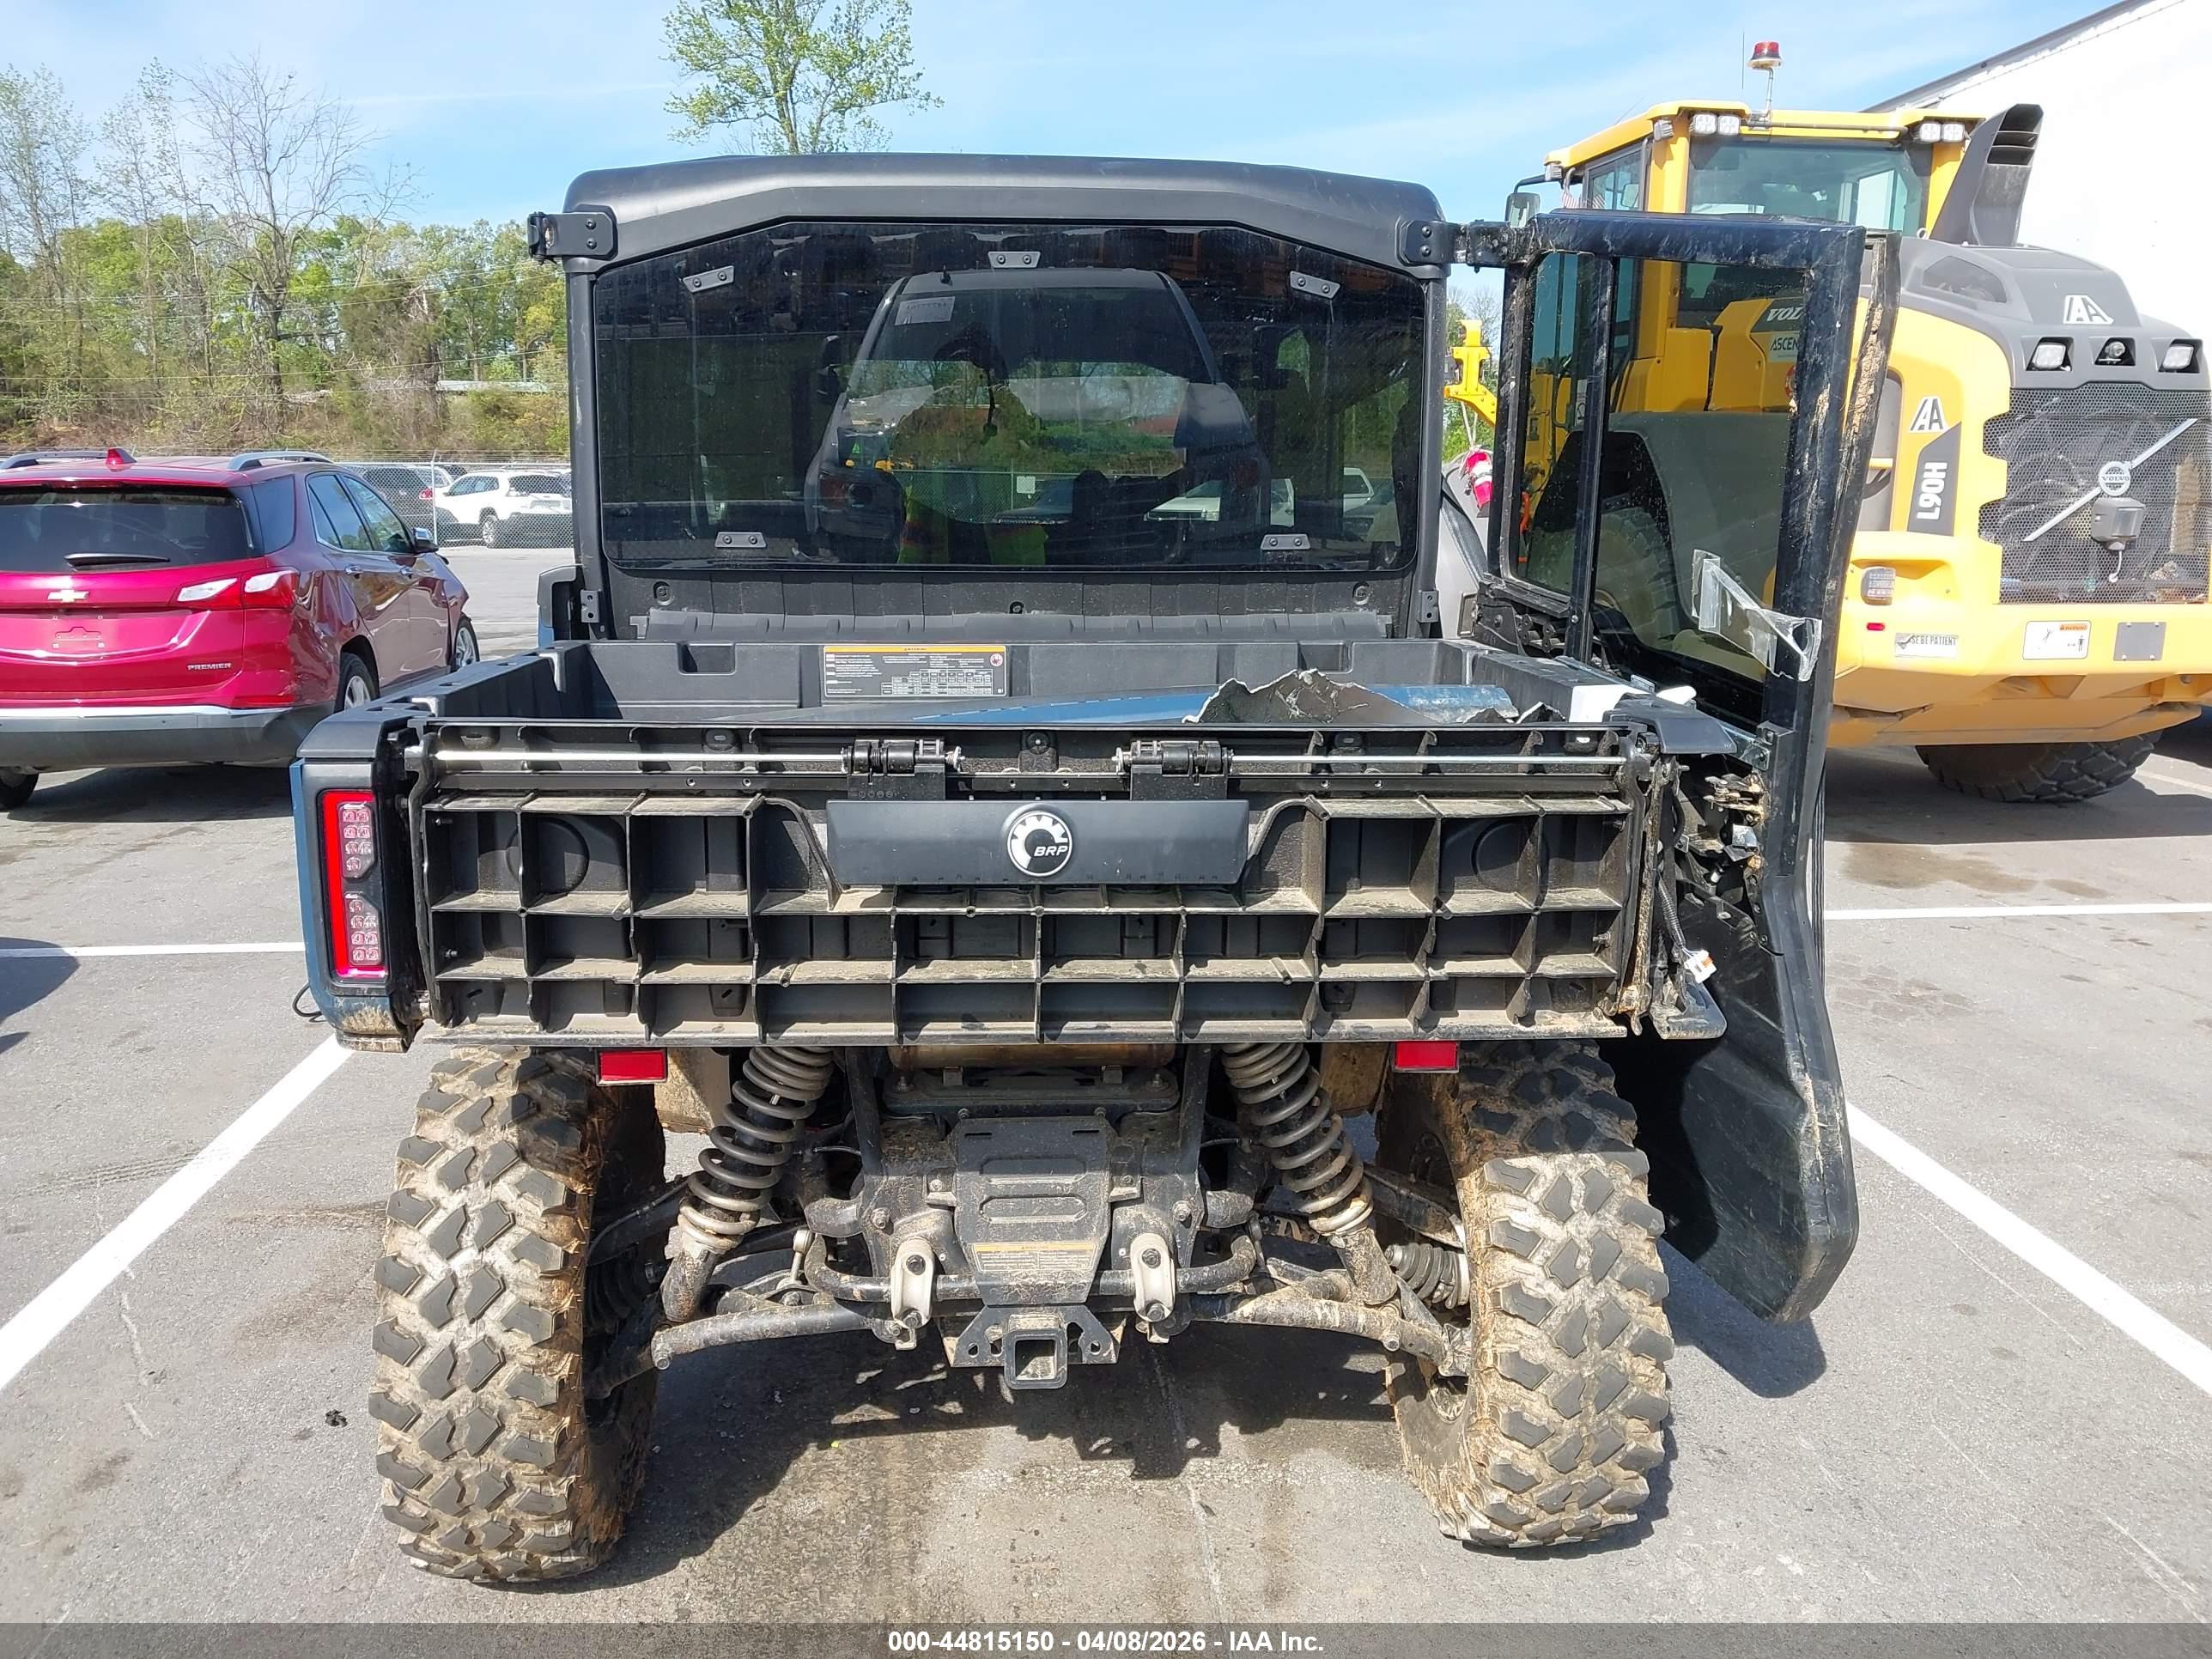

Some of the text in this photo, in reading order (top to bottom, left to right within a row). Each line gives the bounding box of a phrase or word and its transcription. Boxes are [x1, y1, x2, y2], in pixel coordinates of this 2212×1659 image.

[1766, 307, 1804, 321] VOL
[1770, 337, 1799, 350] ASCEN
[1917, 462, 1948, 520] L90H
[1034, 845, 1068, 856] BRP
